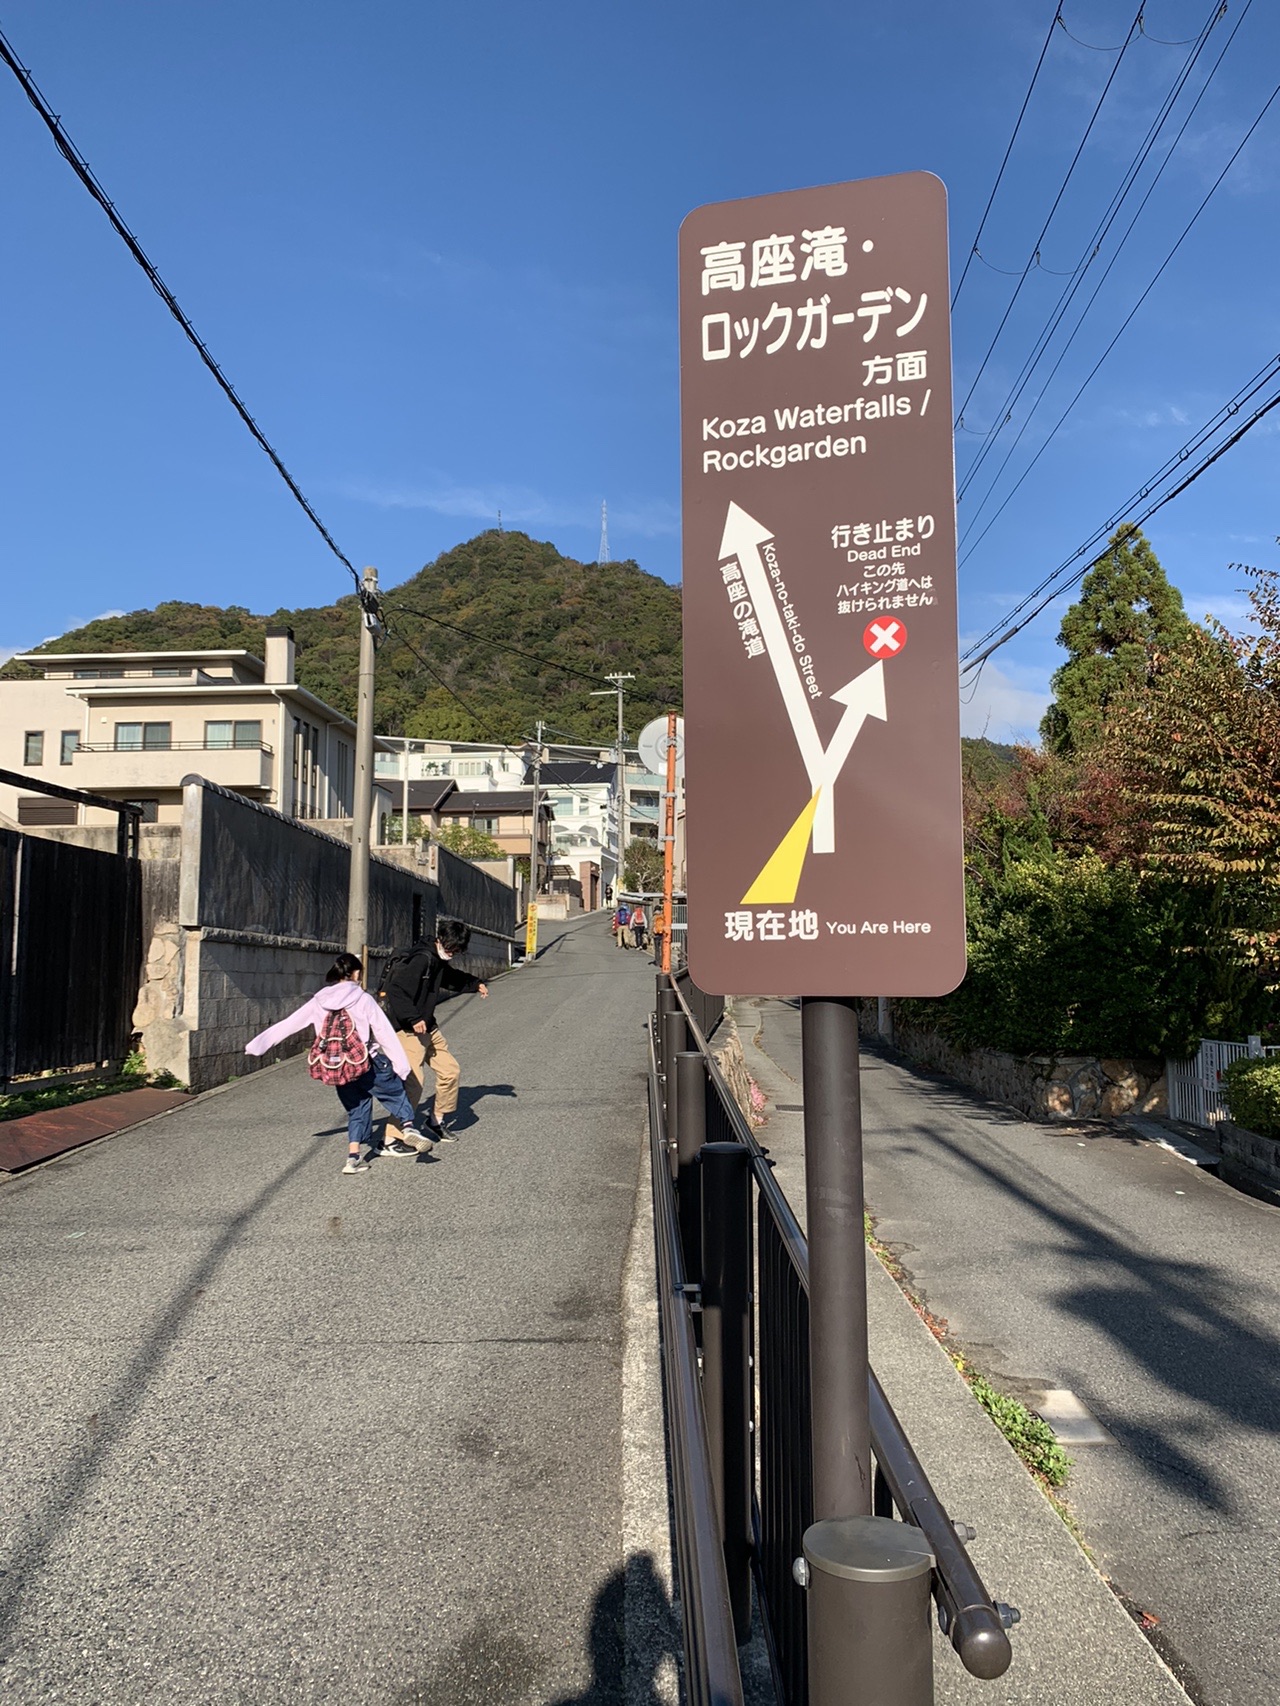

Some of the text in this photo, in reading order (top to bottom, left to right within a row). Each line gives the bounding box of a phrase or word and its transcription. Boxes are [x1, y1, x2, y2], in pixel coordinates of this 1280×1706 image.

[701, 286, 928, 361] ロックガーデン
[862, 350, 928, 387] 方面
[702, 388, 932, 441] Koza Waterfalls /
[703, 435, 867, 474] Rockgarden
[831, 514, 935, 549] 行き止まり
[847, 543, 921, 563] Dead End
[863, 561, 906, 578] この先
[836, 575, 934, 598] ハイキング道へは
[837, 592, 934, 615] 抜けられません
[719, 560, 767, 659] 高座の滝道
[762, 542, 823, 700] Koza-no-taki-do Street
[724, 908, 819, 941] 現在地
[826, 920, 932, 935] You Are Here
